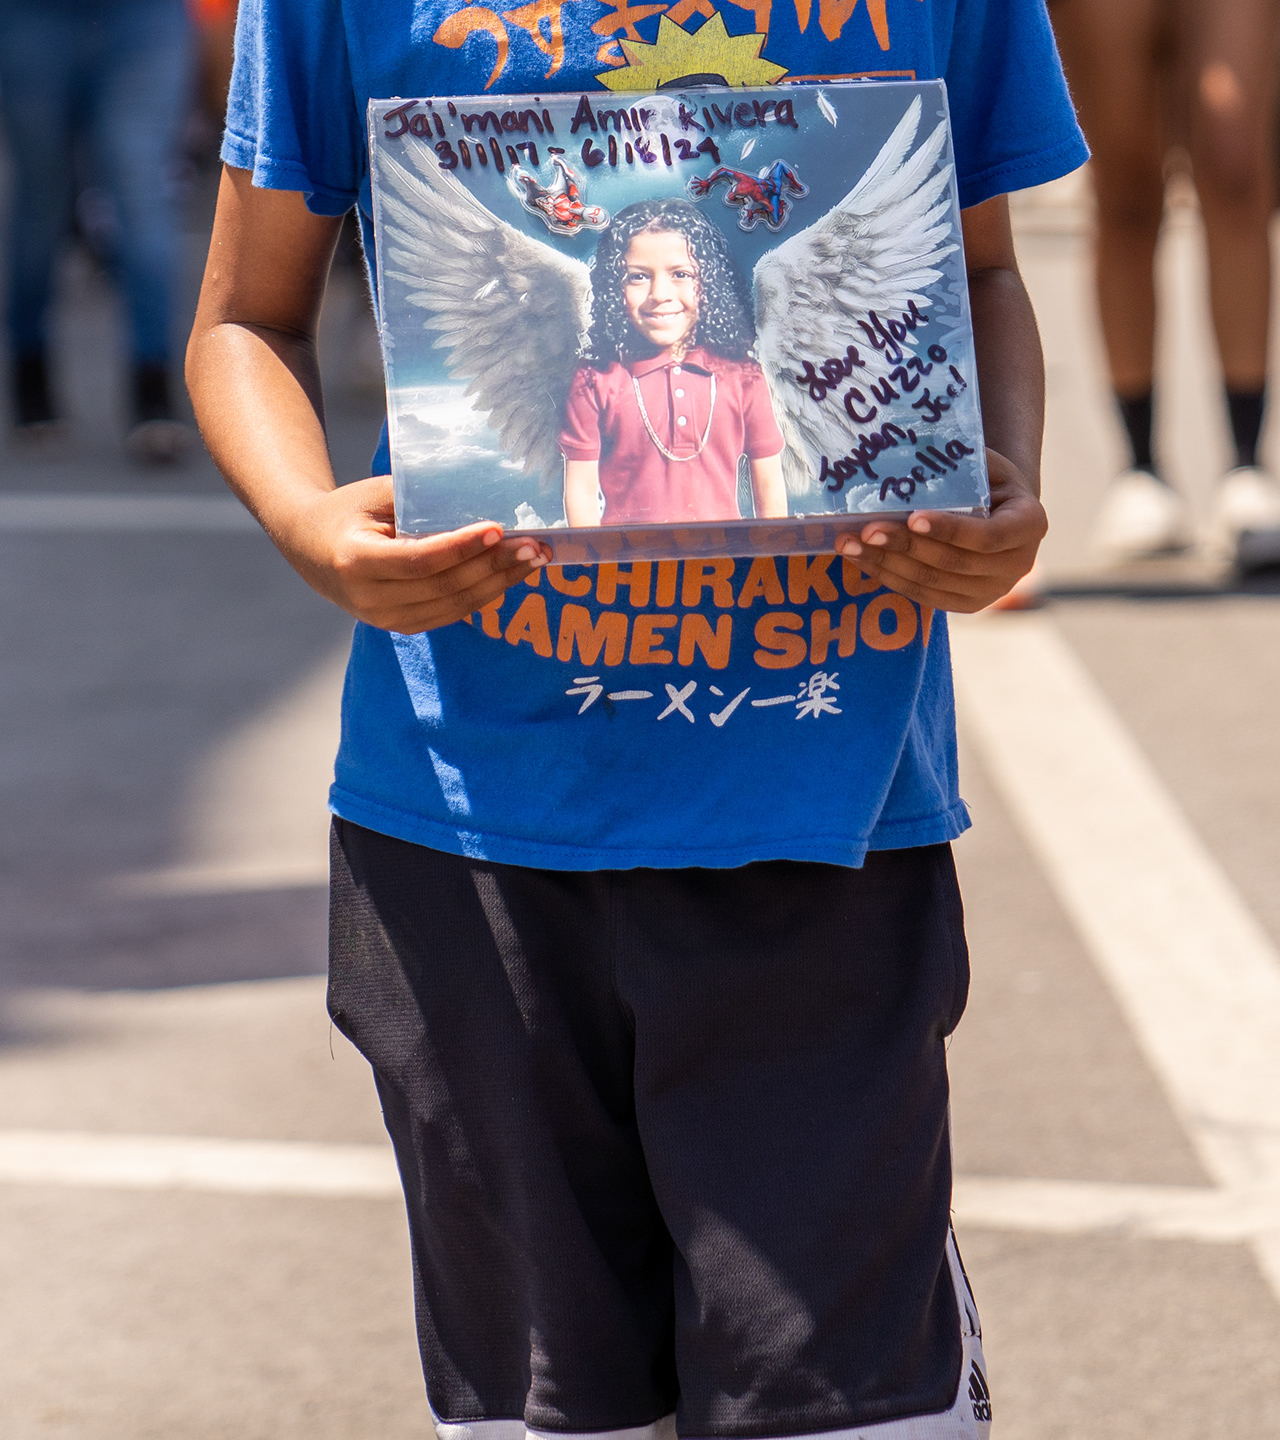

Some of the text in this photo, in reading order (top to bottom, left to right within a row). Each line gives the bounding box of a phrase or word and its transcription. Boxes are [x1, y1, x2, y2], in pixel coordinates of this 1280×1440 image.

[570, 95, 657, 134] Amir
[672, 94, 799, 133] Rivera
[753, 592, 934, 669] SHO
